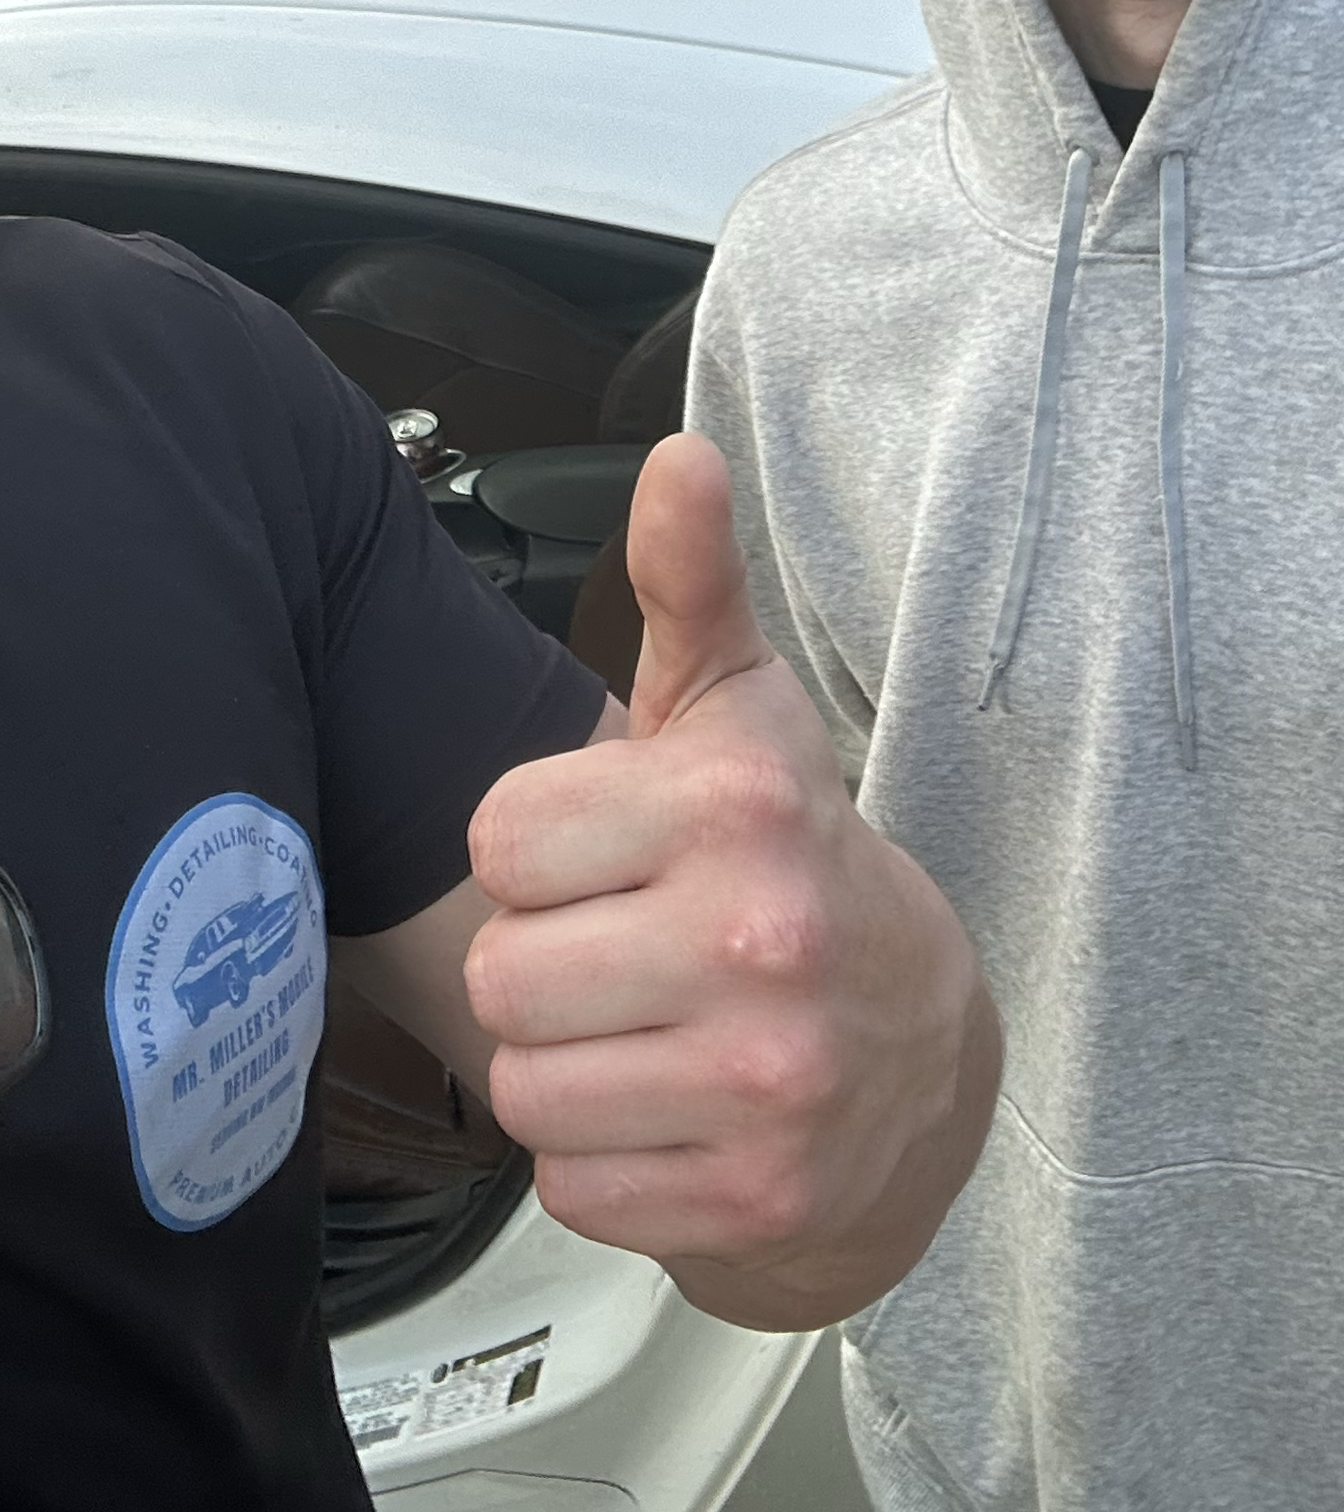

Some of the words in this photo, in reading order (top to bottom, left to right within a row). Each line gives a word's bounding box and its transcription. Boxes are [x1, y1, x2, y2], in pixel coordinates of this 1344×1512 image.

[134, 912, 169, 1069] WASHING
[169, 824, 257, 899] DETAILING
[172, 1060, 206, 1103] MR.
[209, 999, 275, 1075] MILLER'S
[223, 1028, 289, 1108] DETAILING
